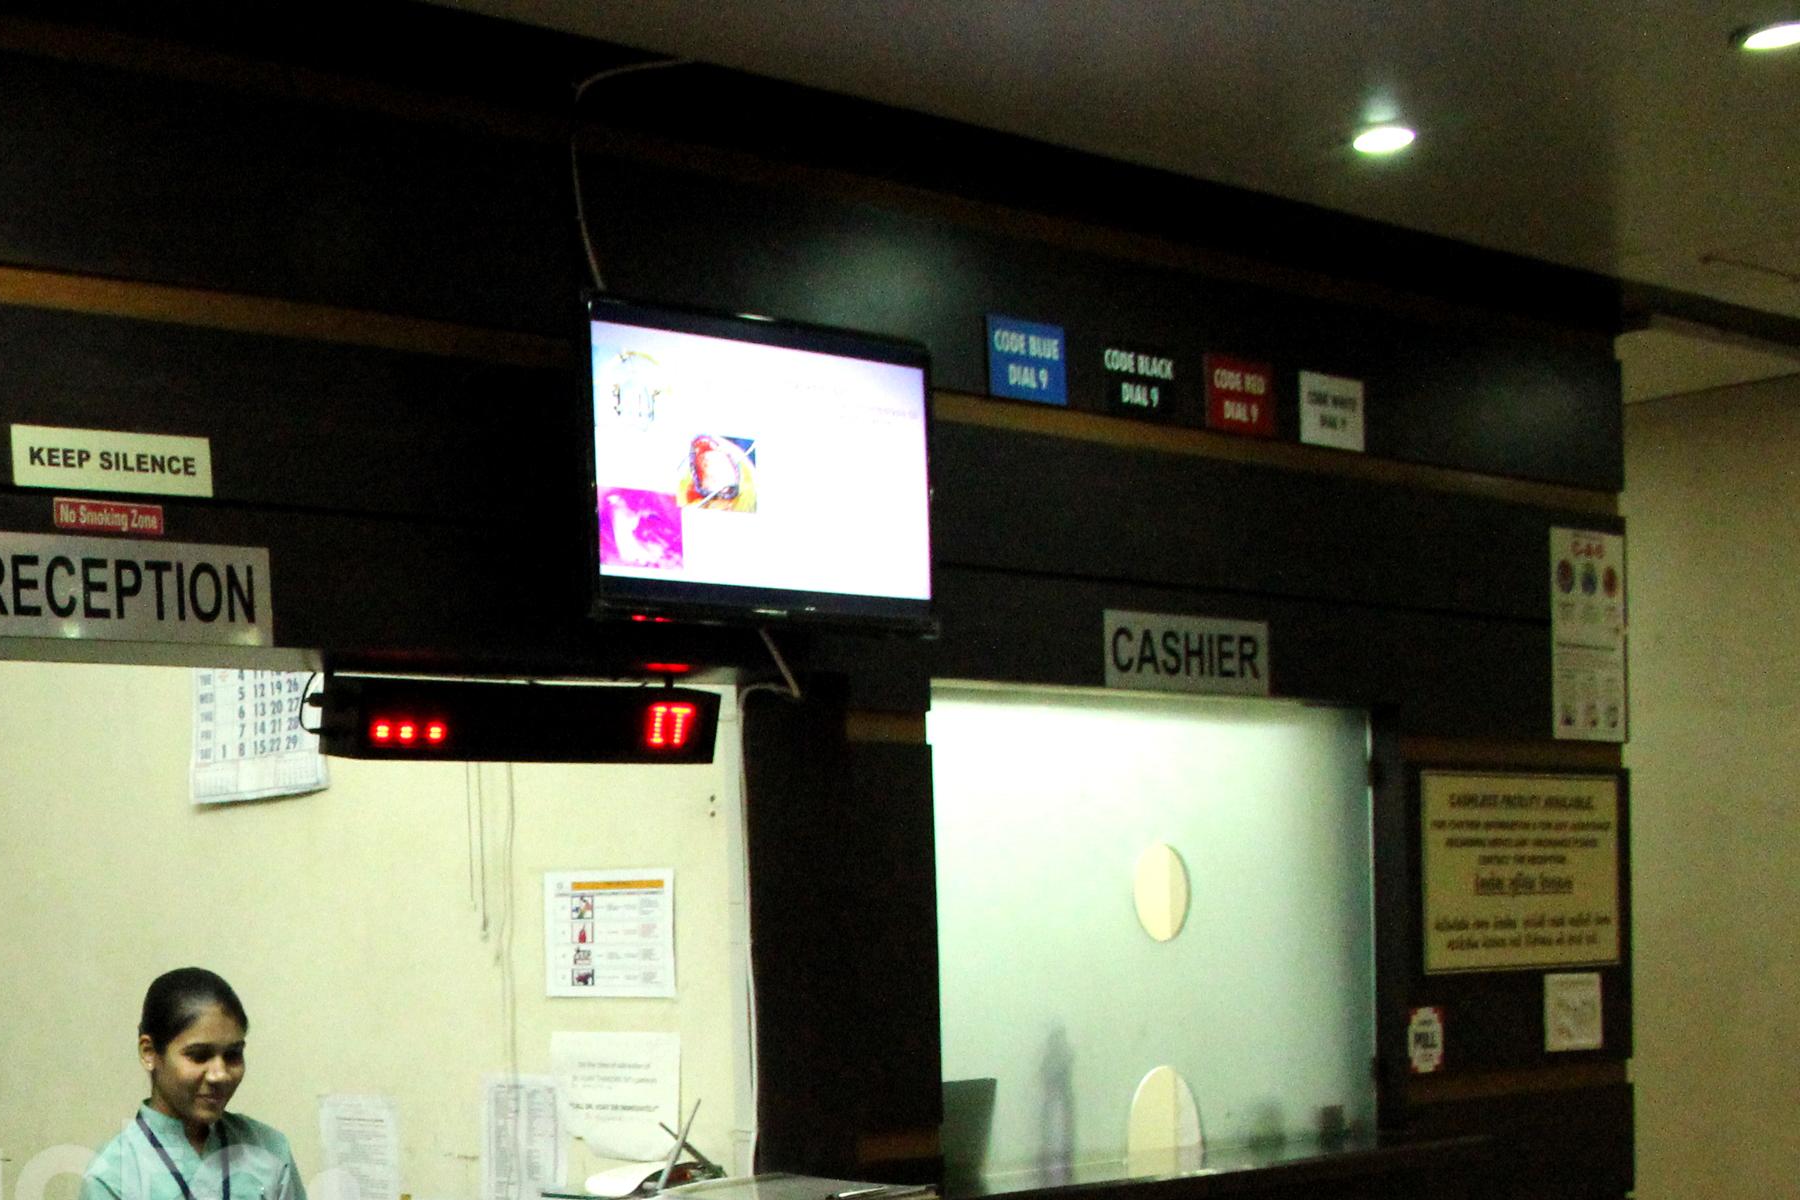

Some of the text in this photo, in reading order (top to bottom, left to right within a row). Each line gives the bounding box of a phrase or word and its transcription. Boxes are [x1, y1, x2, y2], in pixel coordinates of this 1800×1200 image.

[994, 328, 1060, 361] CODE BLUE
[1008, 364, 1049, 390] DIAL 9
[1104, 348, 1174, 381] CODE BLACK
[1214, 368, 1242, 392] CODE
[1121, 382, 1159, 408] DIAL 9
[1224, 399, 1249, 423] DIAL
[29, 446, 196, 476] KEEP SILENCE
[59, 504, 157, 532] No Smoking Zone
[1112, 626, 1261, 679] CASHIER
[238, 688, 245, 700] 5
[254, 684, 265, 698] 12
[271, 682, 282, 695] 19
[287, 679, 299, 693] 26
[238, 707, 245, 719] 6
[254, 704, 266, 716] 13
[270, 701, 283, 714] 20
[287, 698, 300, 712] 27
[239, 725, 245, 737] 7
[254, 722, 266, 735] 14
[271, 719, 282, 733] 21
[239, 742, 245, 757] 8
[254, 741, 266, 754] 15
[269, 738, 281, 752] 22
[286, 735, 298, 749] 29
